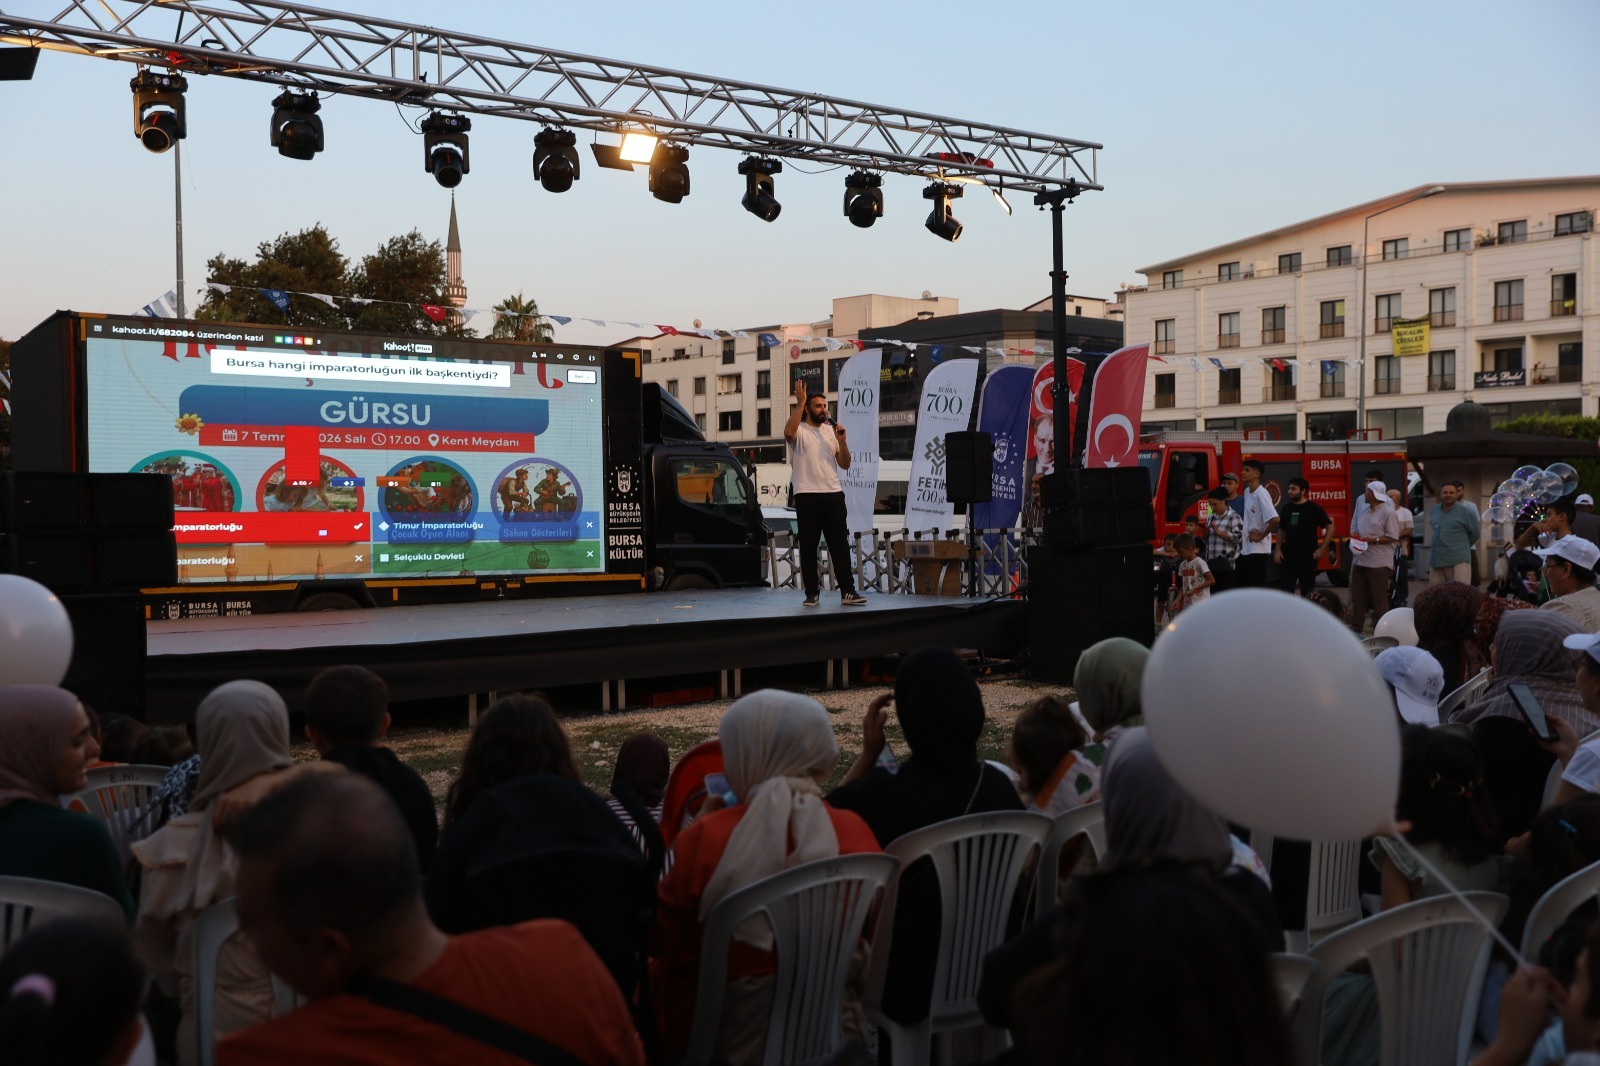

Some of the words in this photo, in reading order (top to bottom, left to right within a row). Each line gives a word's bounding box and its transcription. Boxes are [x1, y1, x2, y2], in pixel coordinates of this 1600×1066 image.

[197, 332, 242, 341] üzerinden
[245, 334, 264, 342] katıl
[383, 342, 415, 352] Kahoot!
[226, 358, 265, 368] Bursa
[269, 360, 306, 372] hangi
[309, 361, 406, 376] imparatorluğun
[409, 366, 423, 376] ilk
[426, 368, 498, 380] başkentiydi?
[320, 396, 431, 426] GÜRSU
[241, 431, 249, 440] 7
[318, 434, 342, 443] 026
[344, 434, 366, 443] Salı
[389, 435, 421, 445] 17.00
[442, 436, 469, 446] Kent
[472, 437, 519, 448] Meydanı
[1310, 460, 1342, 470] BURSA
[1308, 488, 1347, 501] İTFAİYESİ
[609, 502, 641, 511] BURSA
[609, 516, 642, 524] BELEDİYESİ
[393, 522, 420, 530] Timur
[421, 521, 484, 531] İmparatorluğu
[391, 529, 418, 540] Çocuk
[420, 529, 443, 540] Oyun
[445, 529, 469, 538] Alanı
[503, 528, 529, 537] Sahne
[531, 528, 572, 537] Gösterileri
[609, 534, 643, 546] BURSA
[393, 553, 432, 562] Selçuklu
[434, 552, 465, 561] Devleti
[609, 547, 644, 560] KÜLTÜR
[226, 601, 252, 609] BURSA
